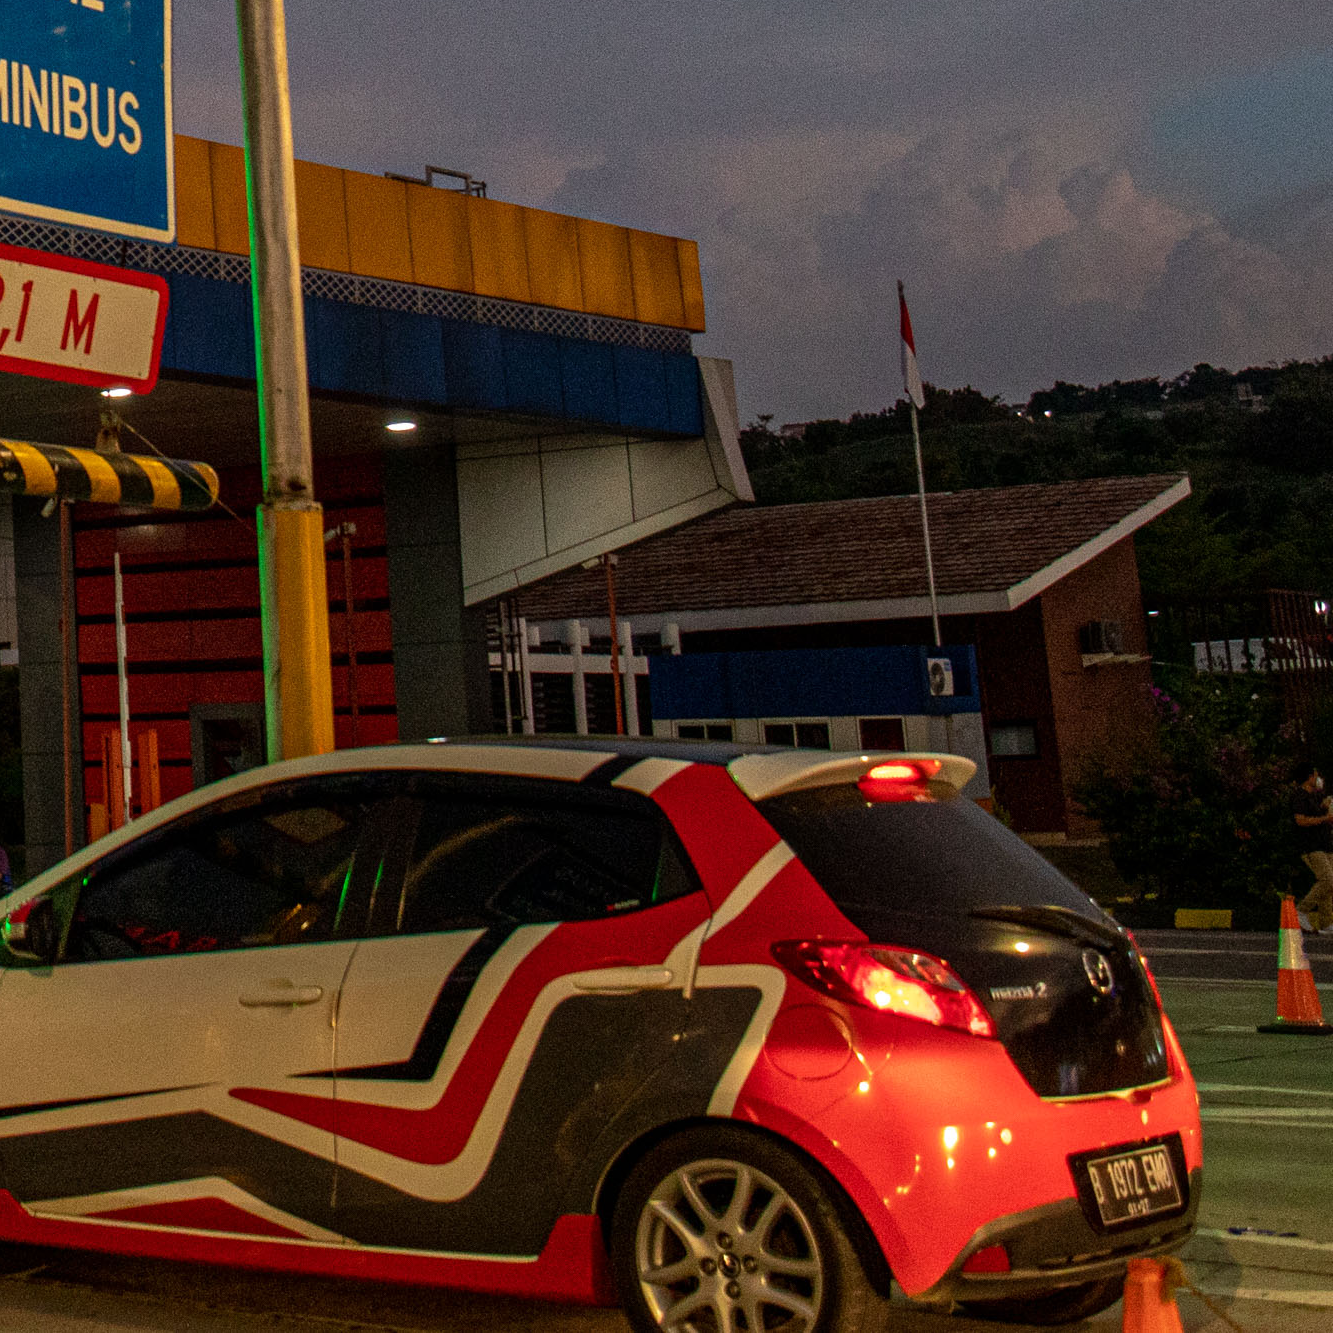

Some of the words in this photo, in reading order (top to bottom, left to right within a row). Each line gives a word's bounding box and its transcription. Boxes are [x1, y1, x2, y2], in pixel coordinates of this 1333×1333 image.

[60, 289, 100, 355] M
[1088, 1166, 1105, 1205] B
[1107, 1158, 1145, 1201] 1972
